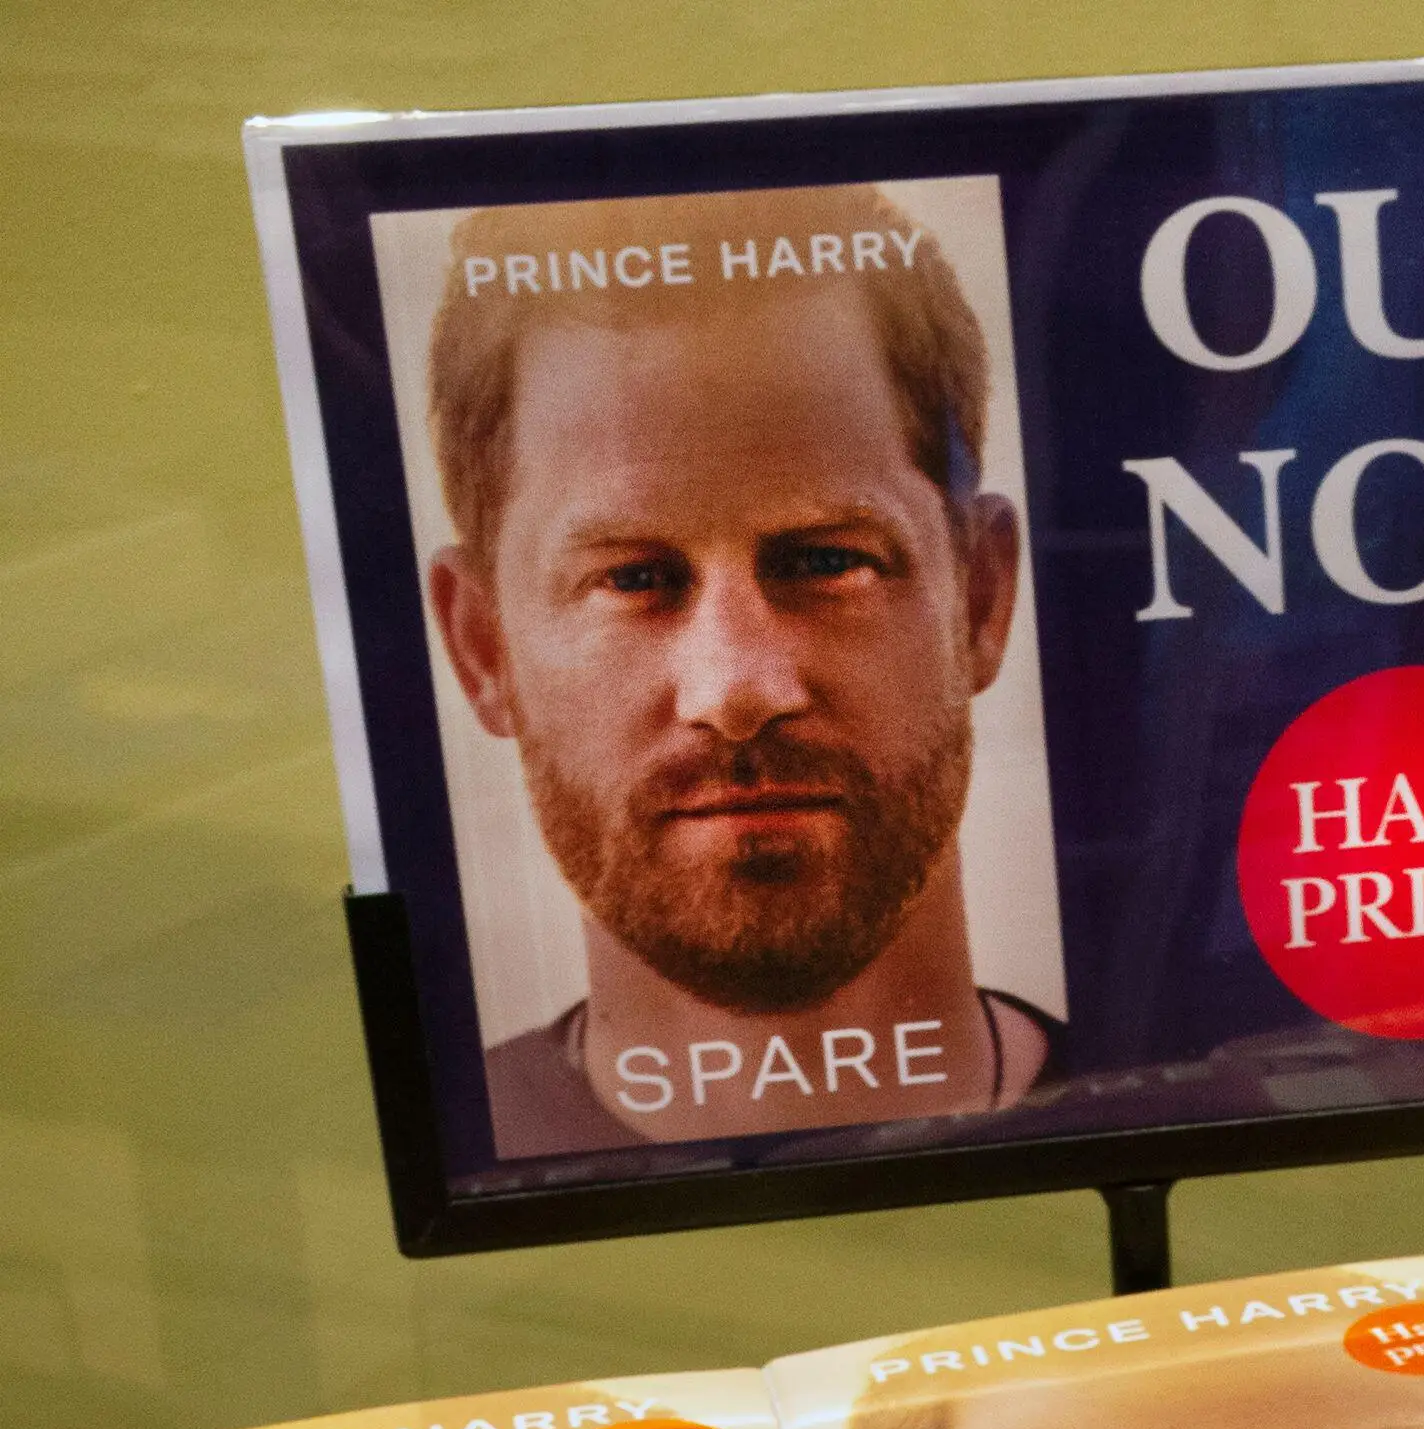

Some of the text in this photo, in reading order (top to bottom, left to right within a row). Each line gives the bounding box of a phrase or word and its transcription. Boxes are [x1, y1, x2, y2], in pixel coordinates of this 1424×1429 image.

[465, 230, 923, 297] PRINCE HARRY
[616, 1020, 948, 1114] SPARE
[868, 1278, 1421, 1384] PRINCE HARRY
